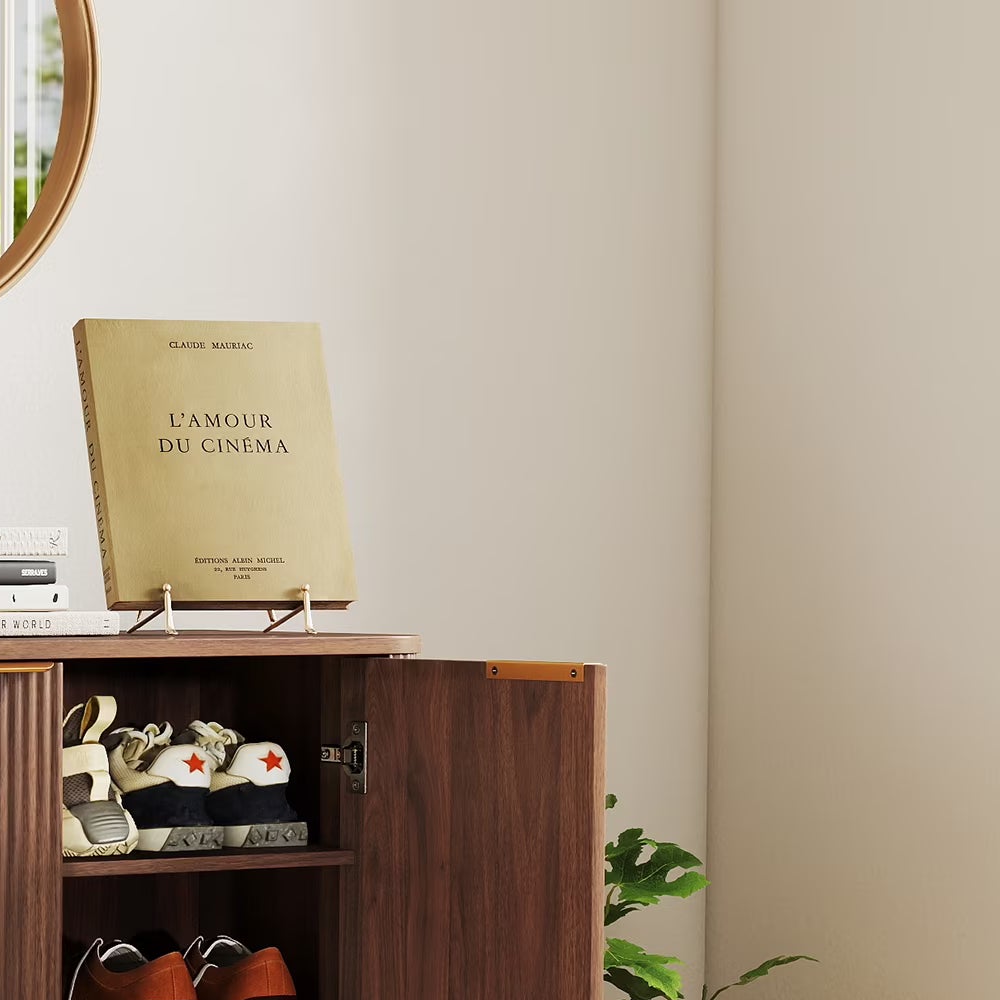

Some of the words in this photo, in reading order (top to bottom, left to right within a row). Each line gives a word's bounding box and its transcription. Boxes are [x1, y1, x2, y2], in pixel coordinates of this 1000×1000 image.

[168, 341, 206, 350] CLAUDE
[211, 342, 254, 350] MAURIAC
[169, 412, 273, 429] L'AMOUR
[159, 438, 190, 454] DU
[201, 436, 289, 454] CINÉMA
[88, 442, 97, 472] DU
[194, 556, 229, 564] ÉDITIONS
[13, 619, 52, 630] WORLD
